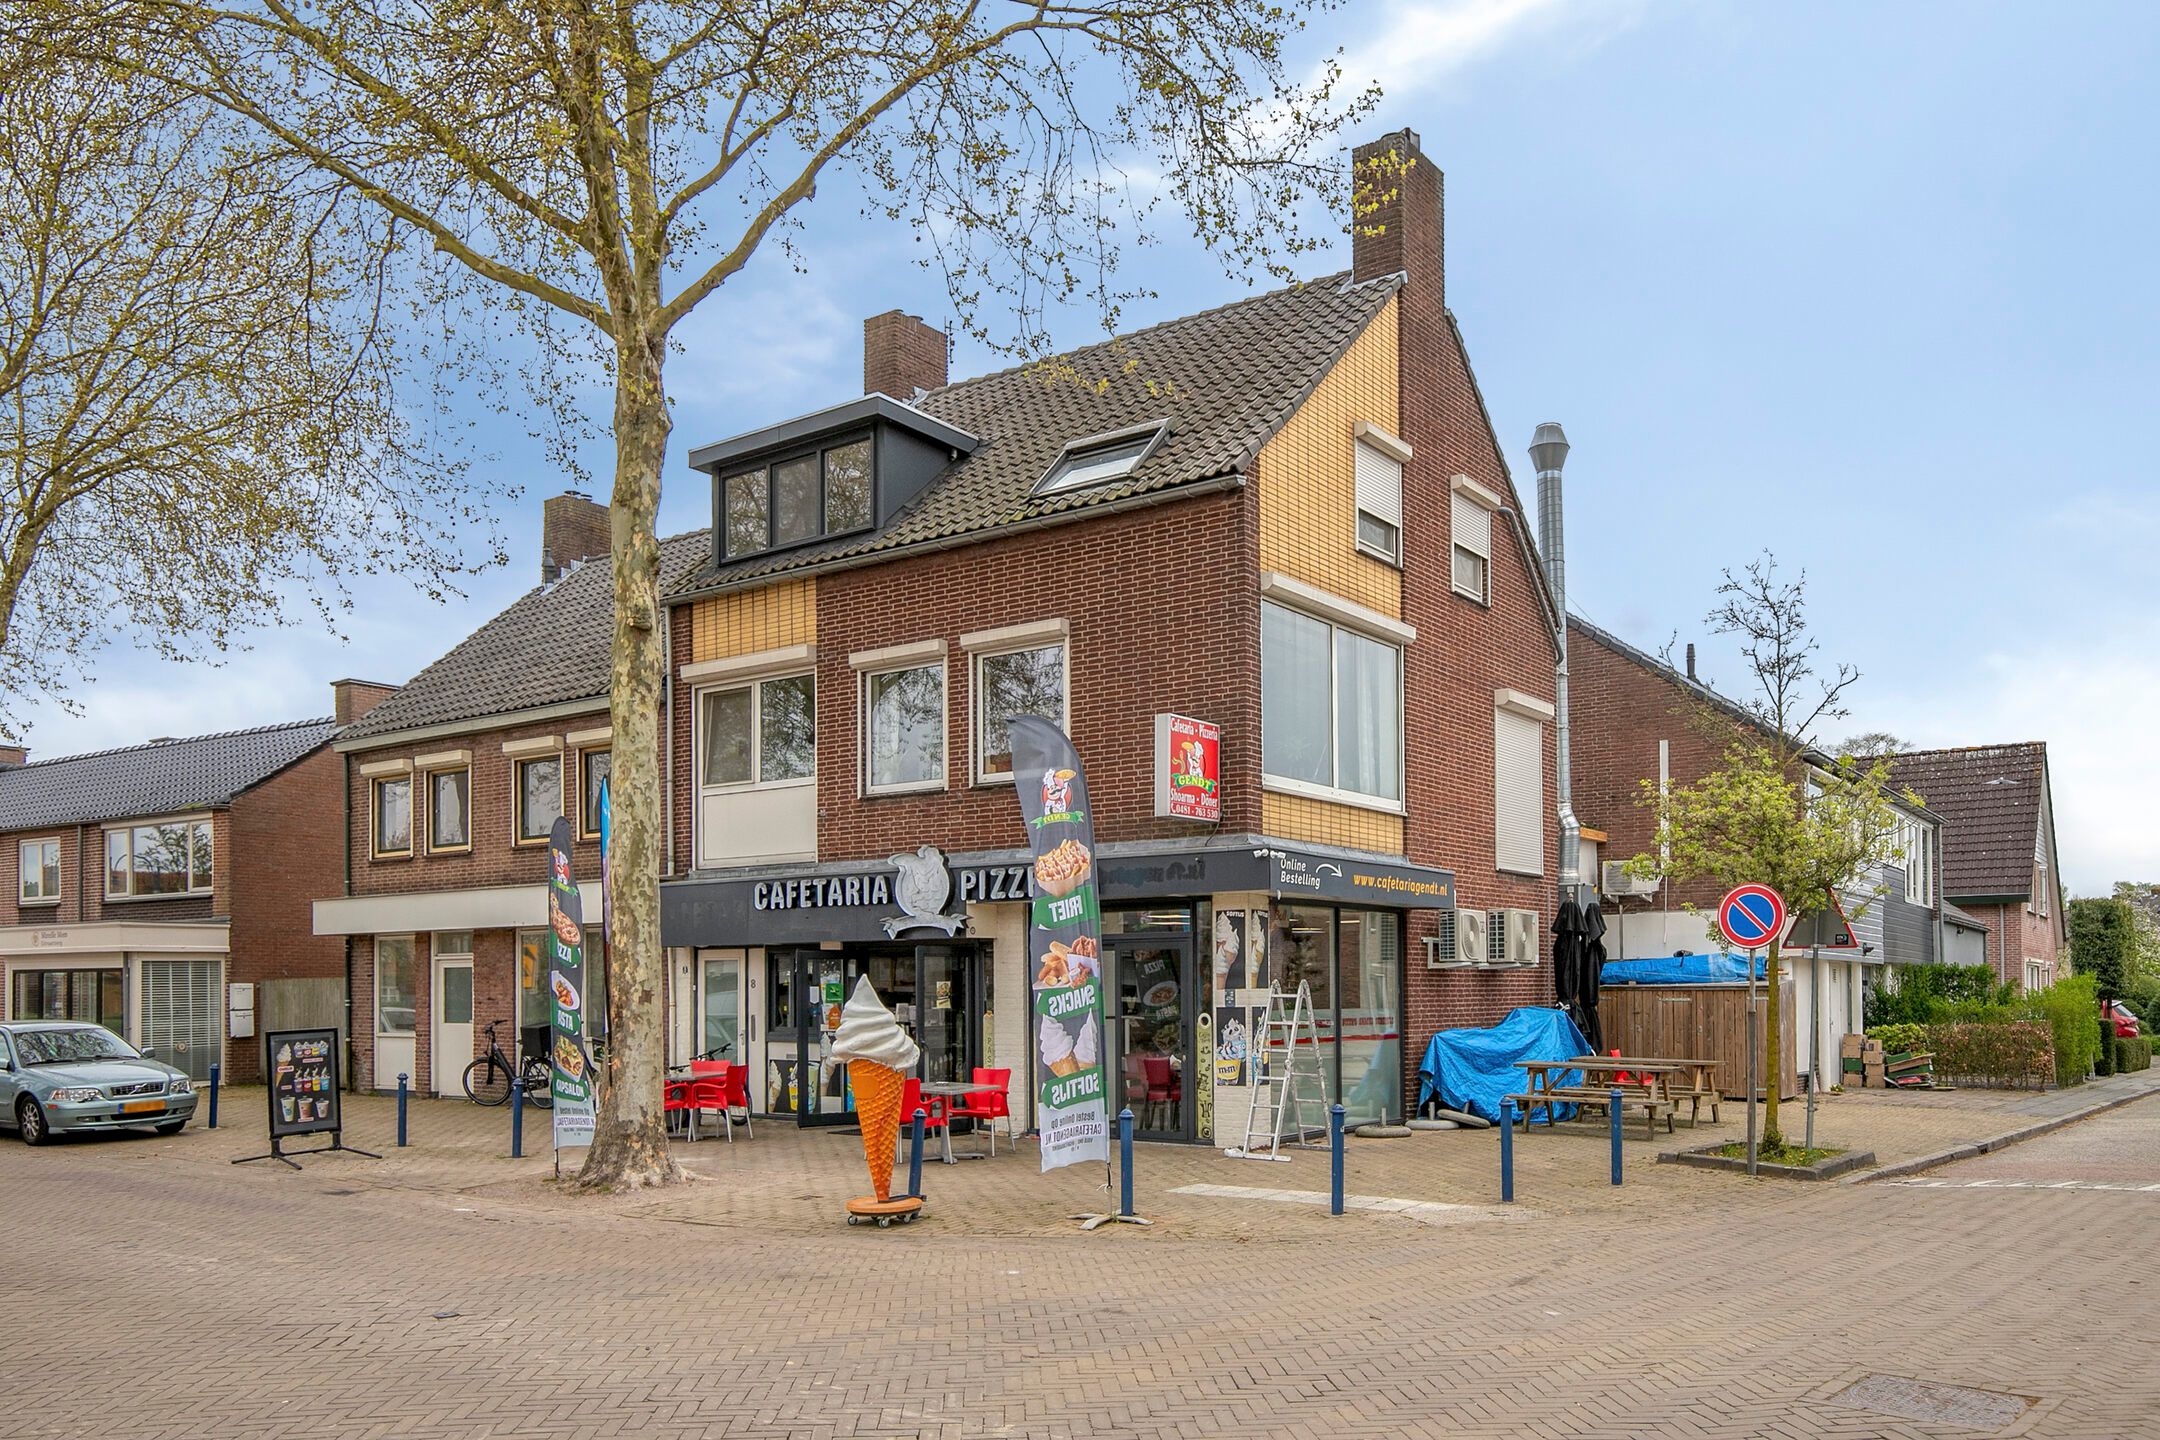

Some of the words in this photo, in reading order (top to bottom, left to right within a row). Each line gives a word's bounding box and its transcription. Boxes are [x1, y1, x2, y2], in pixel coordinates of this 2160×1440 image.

[1171, 717, 1194, 736] Cafetaria
[1178, 774, 1211, 790] GENDT
[1171, 787, 1195, 804] Shoarma
[1280, 858, 1307, 872] Online
[1280, 871, 1321, 889] Bestelling
[1353, 874, 1448, 896] www.cafetariagendt.nl
[754, 875, 888, 910] CAFETARIA
[750, 979, 756, 989] 8
